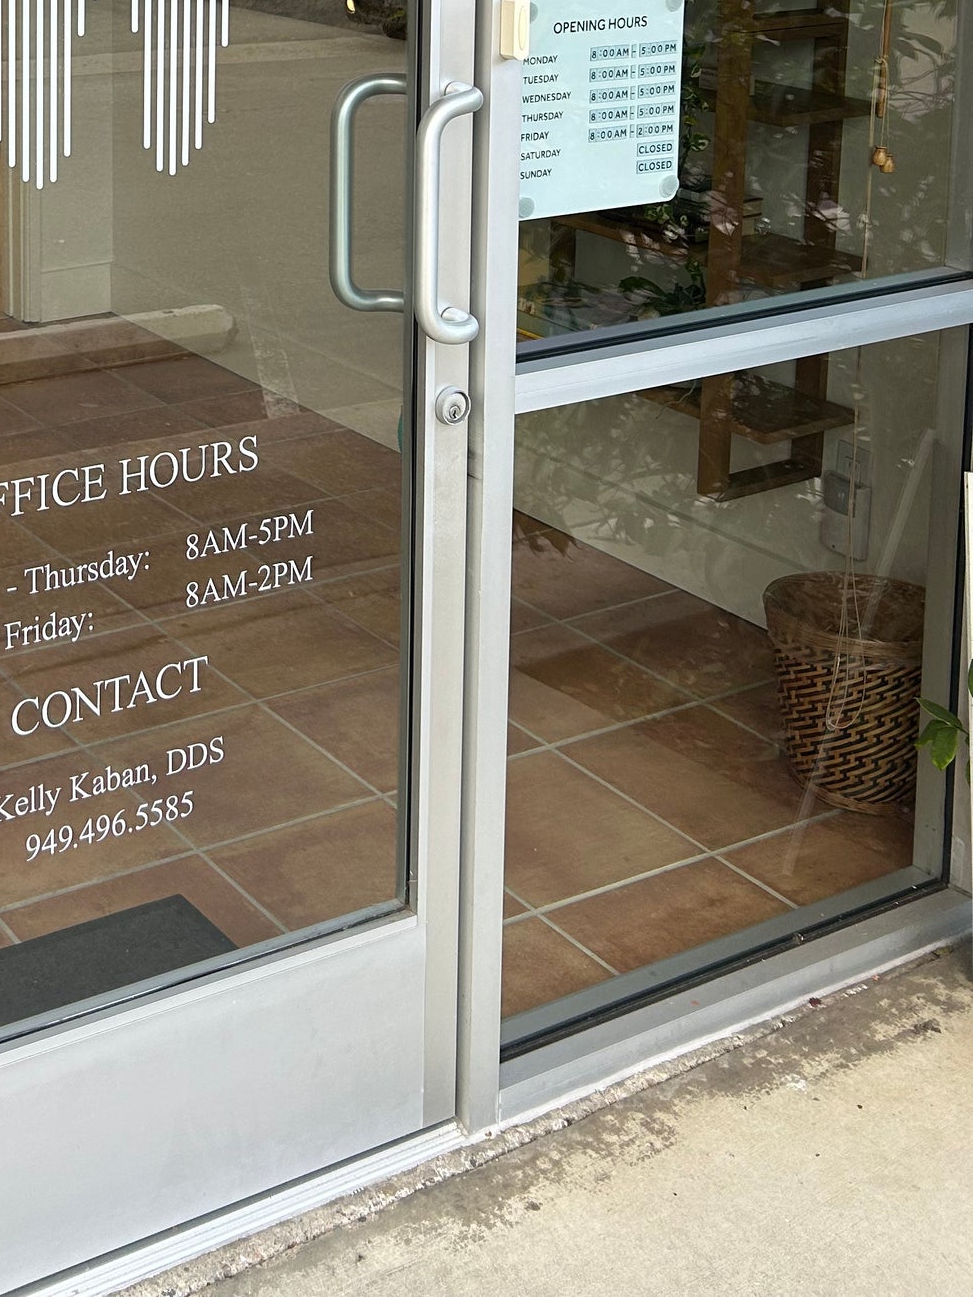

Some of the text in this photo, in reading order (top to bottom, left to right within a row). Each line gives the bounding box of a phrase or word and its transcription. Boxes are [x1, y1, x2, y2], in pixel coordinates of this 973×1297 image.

[553, 15, 648, 35] OPENING HOURS
[523, 55, 558, 66] MONDAY
[523, 74, 559, 85] TUESDAY
[522, 92, 571, 103] WEDNESDAY
[521, 111, 563, 122] THURSDAY
[521, 131, 549, 142] FRIDAY
[520, 143, 673, 161] SATURDAY CLOSED
[520, 161, 672, 180] SUNDAY CLOSED
[119, 435, 260, 497] HOURS
[24, 549, 151, 596] Thursday:
[185, 509, 315, 561] 8AM-5PM
[4, 609, 95, 651] Friday:
[185, 556, 315, 609] 8AM-2PM
[11, 656, 209, 736] CONTACT
[69, 763, 158, 803] Kaban,
[166, 736, 226, 777] DDS
[25, 790, 195, 862] 949.496.5585
